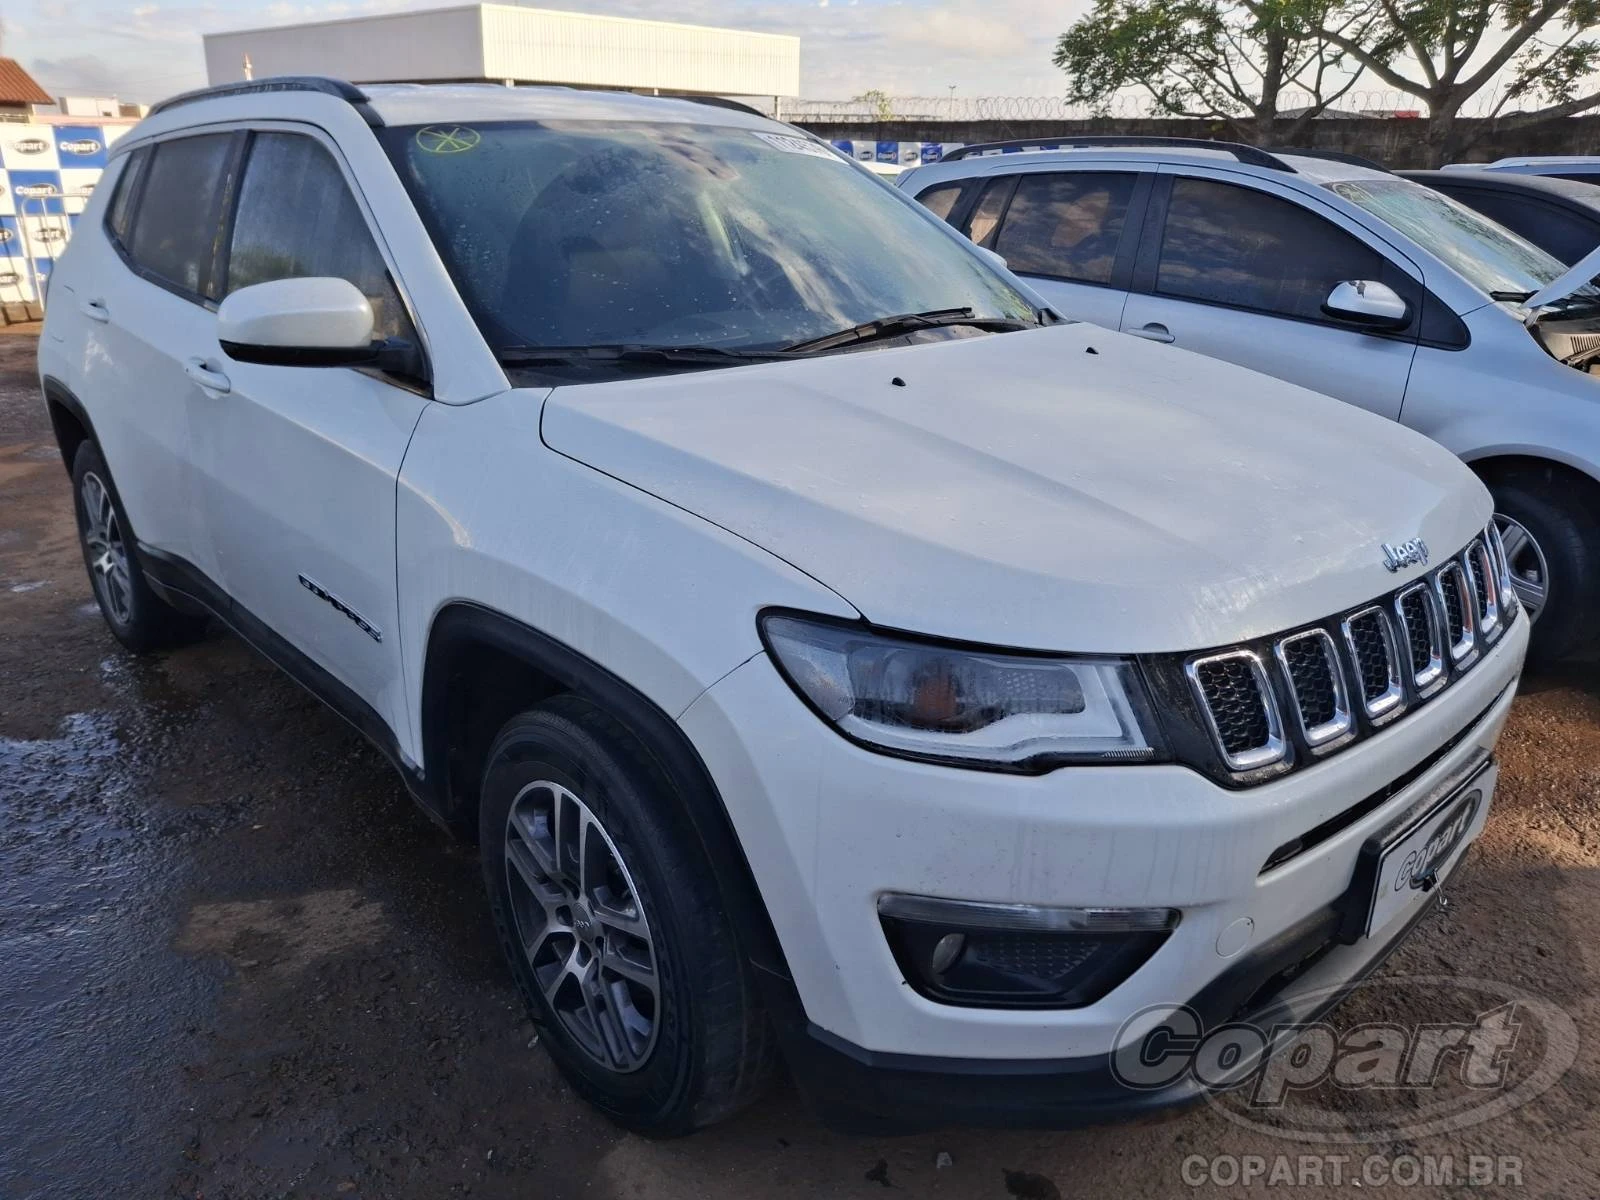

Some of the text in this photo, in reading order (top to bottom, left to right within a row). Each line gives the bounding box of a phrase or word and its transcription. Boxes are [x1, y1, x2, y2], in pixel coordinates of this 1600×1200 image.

[60, 140, 97, 153] Copart
[1381, 537, 1428, 573] Jeep
[1394, 798, 1472, 892] Copart
